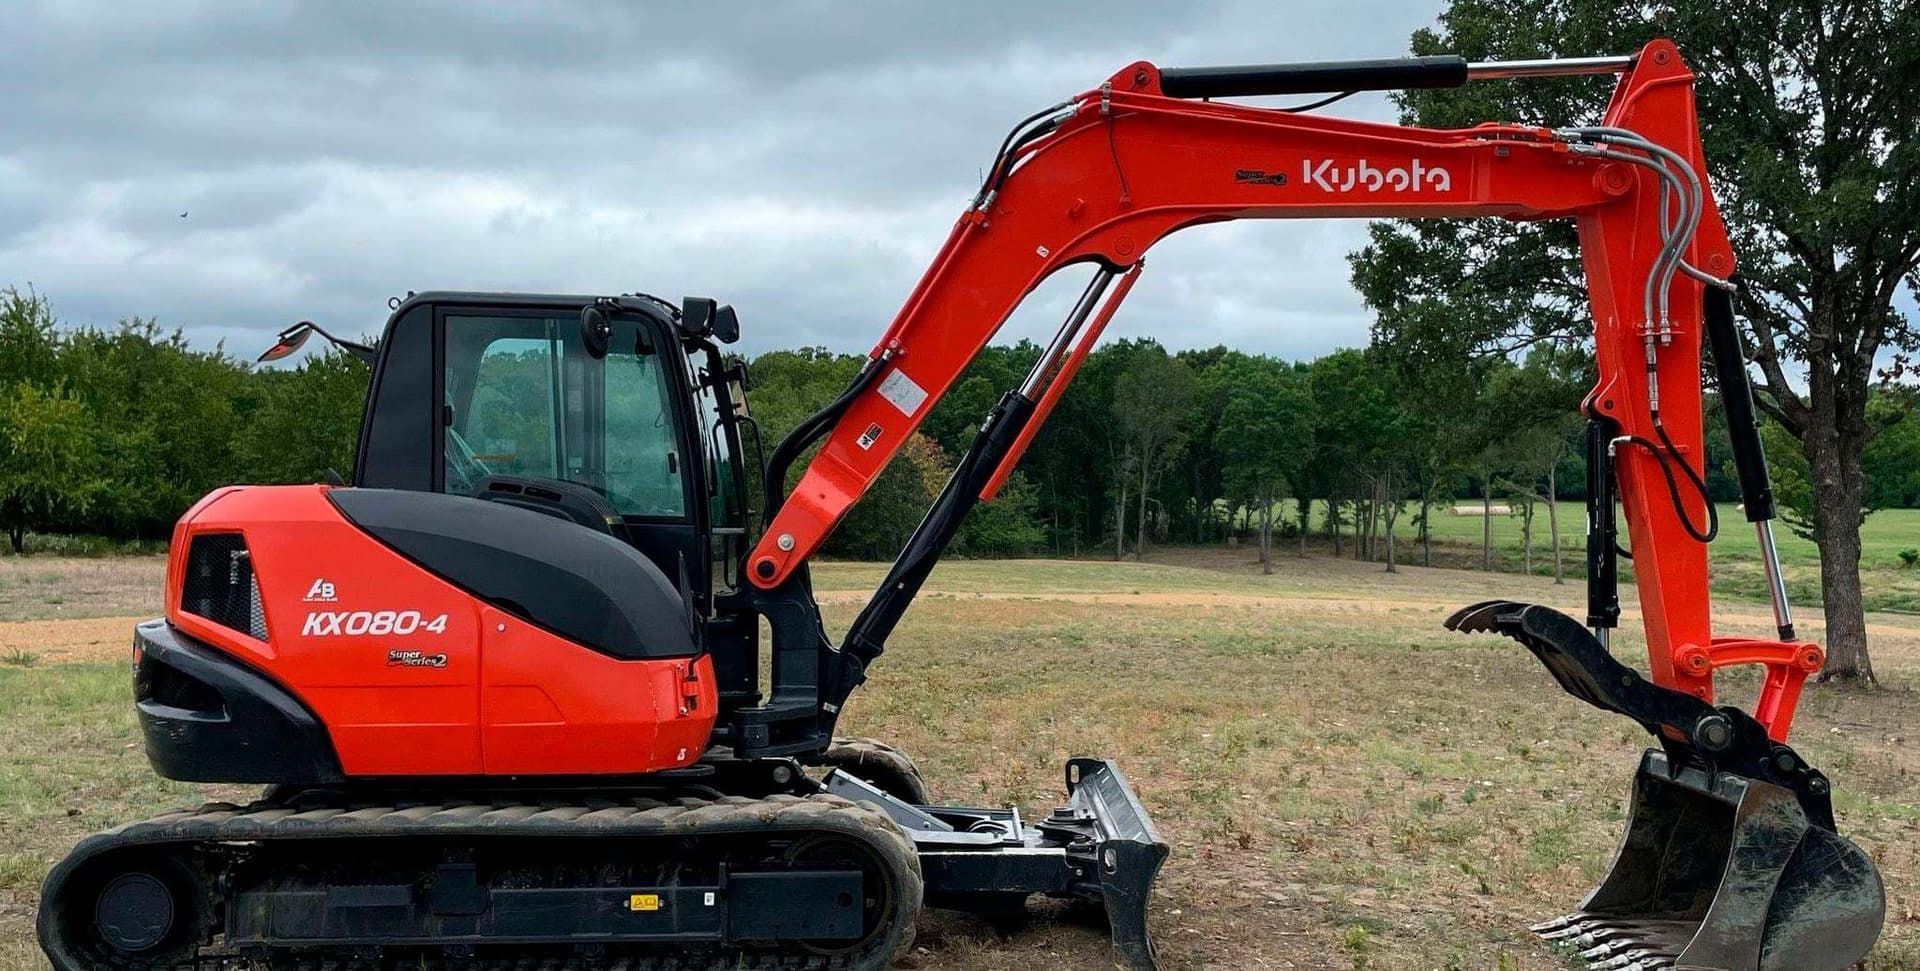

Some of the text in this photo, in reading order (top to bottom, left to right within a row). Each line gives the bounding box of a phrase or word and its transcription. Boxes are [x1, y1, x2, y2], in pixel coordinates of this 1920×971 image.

[1303, 159, 1450, 192] Kubota
[301, 611, 448, 636] KX080-4
[389, 650, 421, 660] Super
